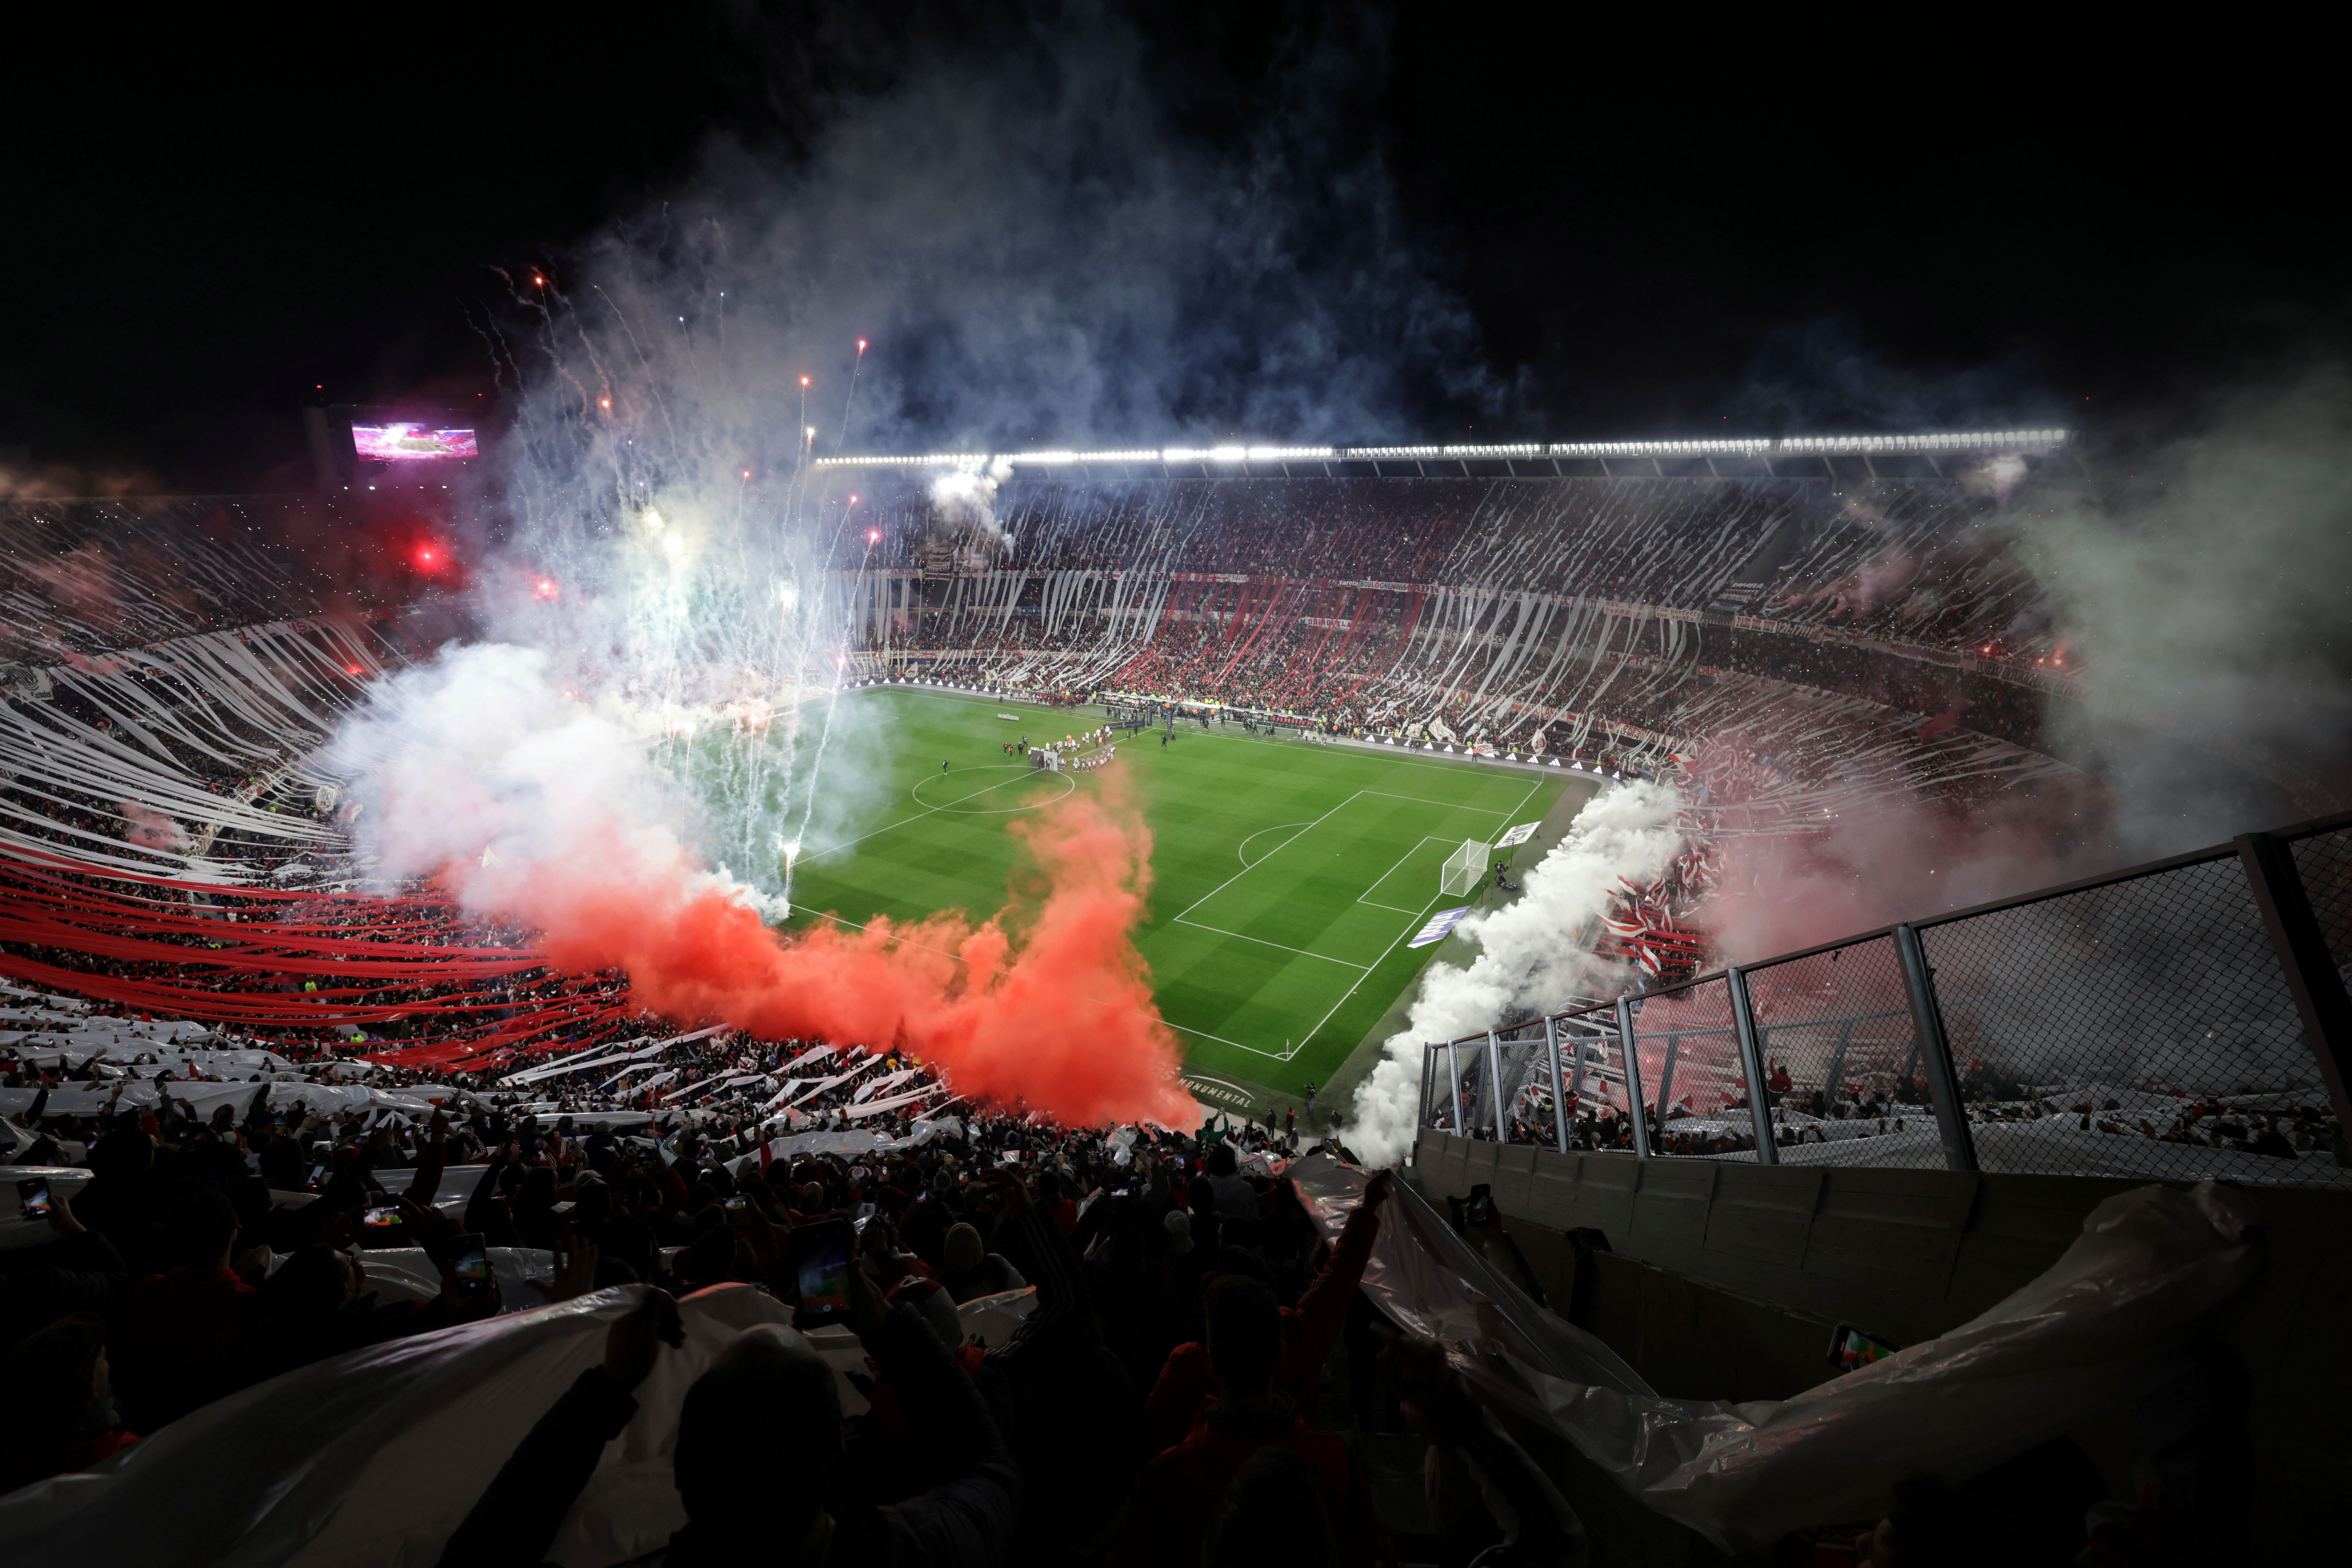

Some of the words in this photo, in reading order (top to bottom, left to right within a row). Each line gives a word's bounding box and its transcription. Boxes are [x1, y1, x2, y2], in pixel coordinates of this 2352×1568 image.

[1123, 573, 1170, 581] MAANZA
[1737, 617, 1750, 629] PASO
[1751, 619, 1762, 630] DEL
[1763, 621, 1776, 632] REY
[1698, 666, 1723, 677] CHUPE
[1616, 723, 1641, 735] FORES
[1616, 730, 1639, 740] JZMIN
[1412, 910, 1467, 941] brubank
[1177, 1078, 1252, 1108] MONUMENTAL
